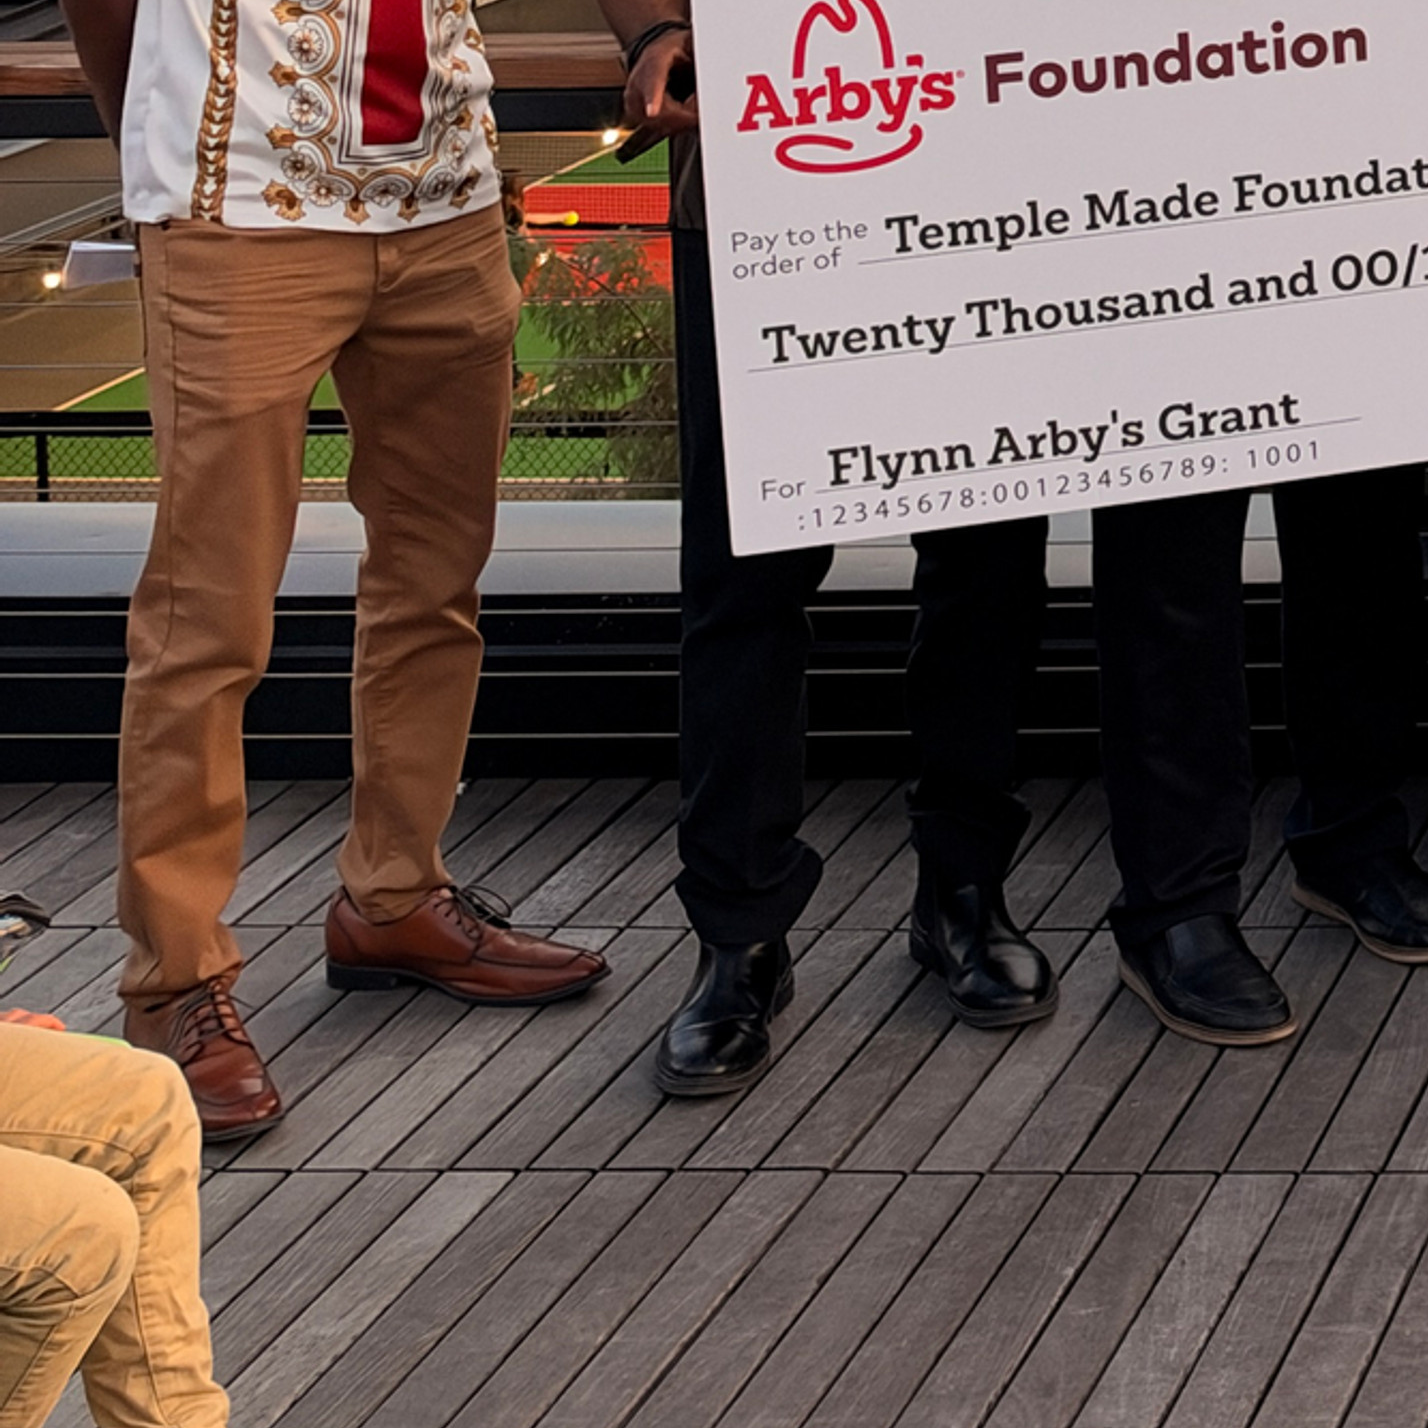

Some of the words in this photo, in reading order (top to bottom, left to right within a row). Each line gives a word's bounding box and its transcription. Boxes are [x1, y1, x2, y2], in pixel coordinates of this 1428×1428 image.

[736, 54, 957, 134] Arby's
[984, 21, 1368, 104] Foundation
[731, 230, 780, 255] Pay
[786, 226, 816, 247] to
[822, 219, 869, 243] the
[885, 200, 1071, 254] Temple
[1084, 183, 1220, 231] Made
[732, 251, 805, 280] order
[813, 246, 843, 270] of
[761, 312, 957, 365] Twenty
[965, 273, 1215, 340] Thousand
[1227, 260, 1319, 303] and
[760, 476, 807, 502] For
[827, 444, 976, 491] Flynn
[986, 409, 1146, 464] Arby's
[1157, 392, 1301, 442] Grant
[1246, 439, 1321, 469] 1001
